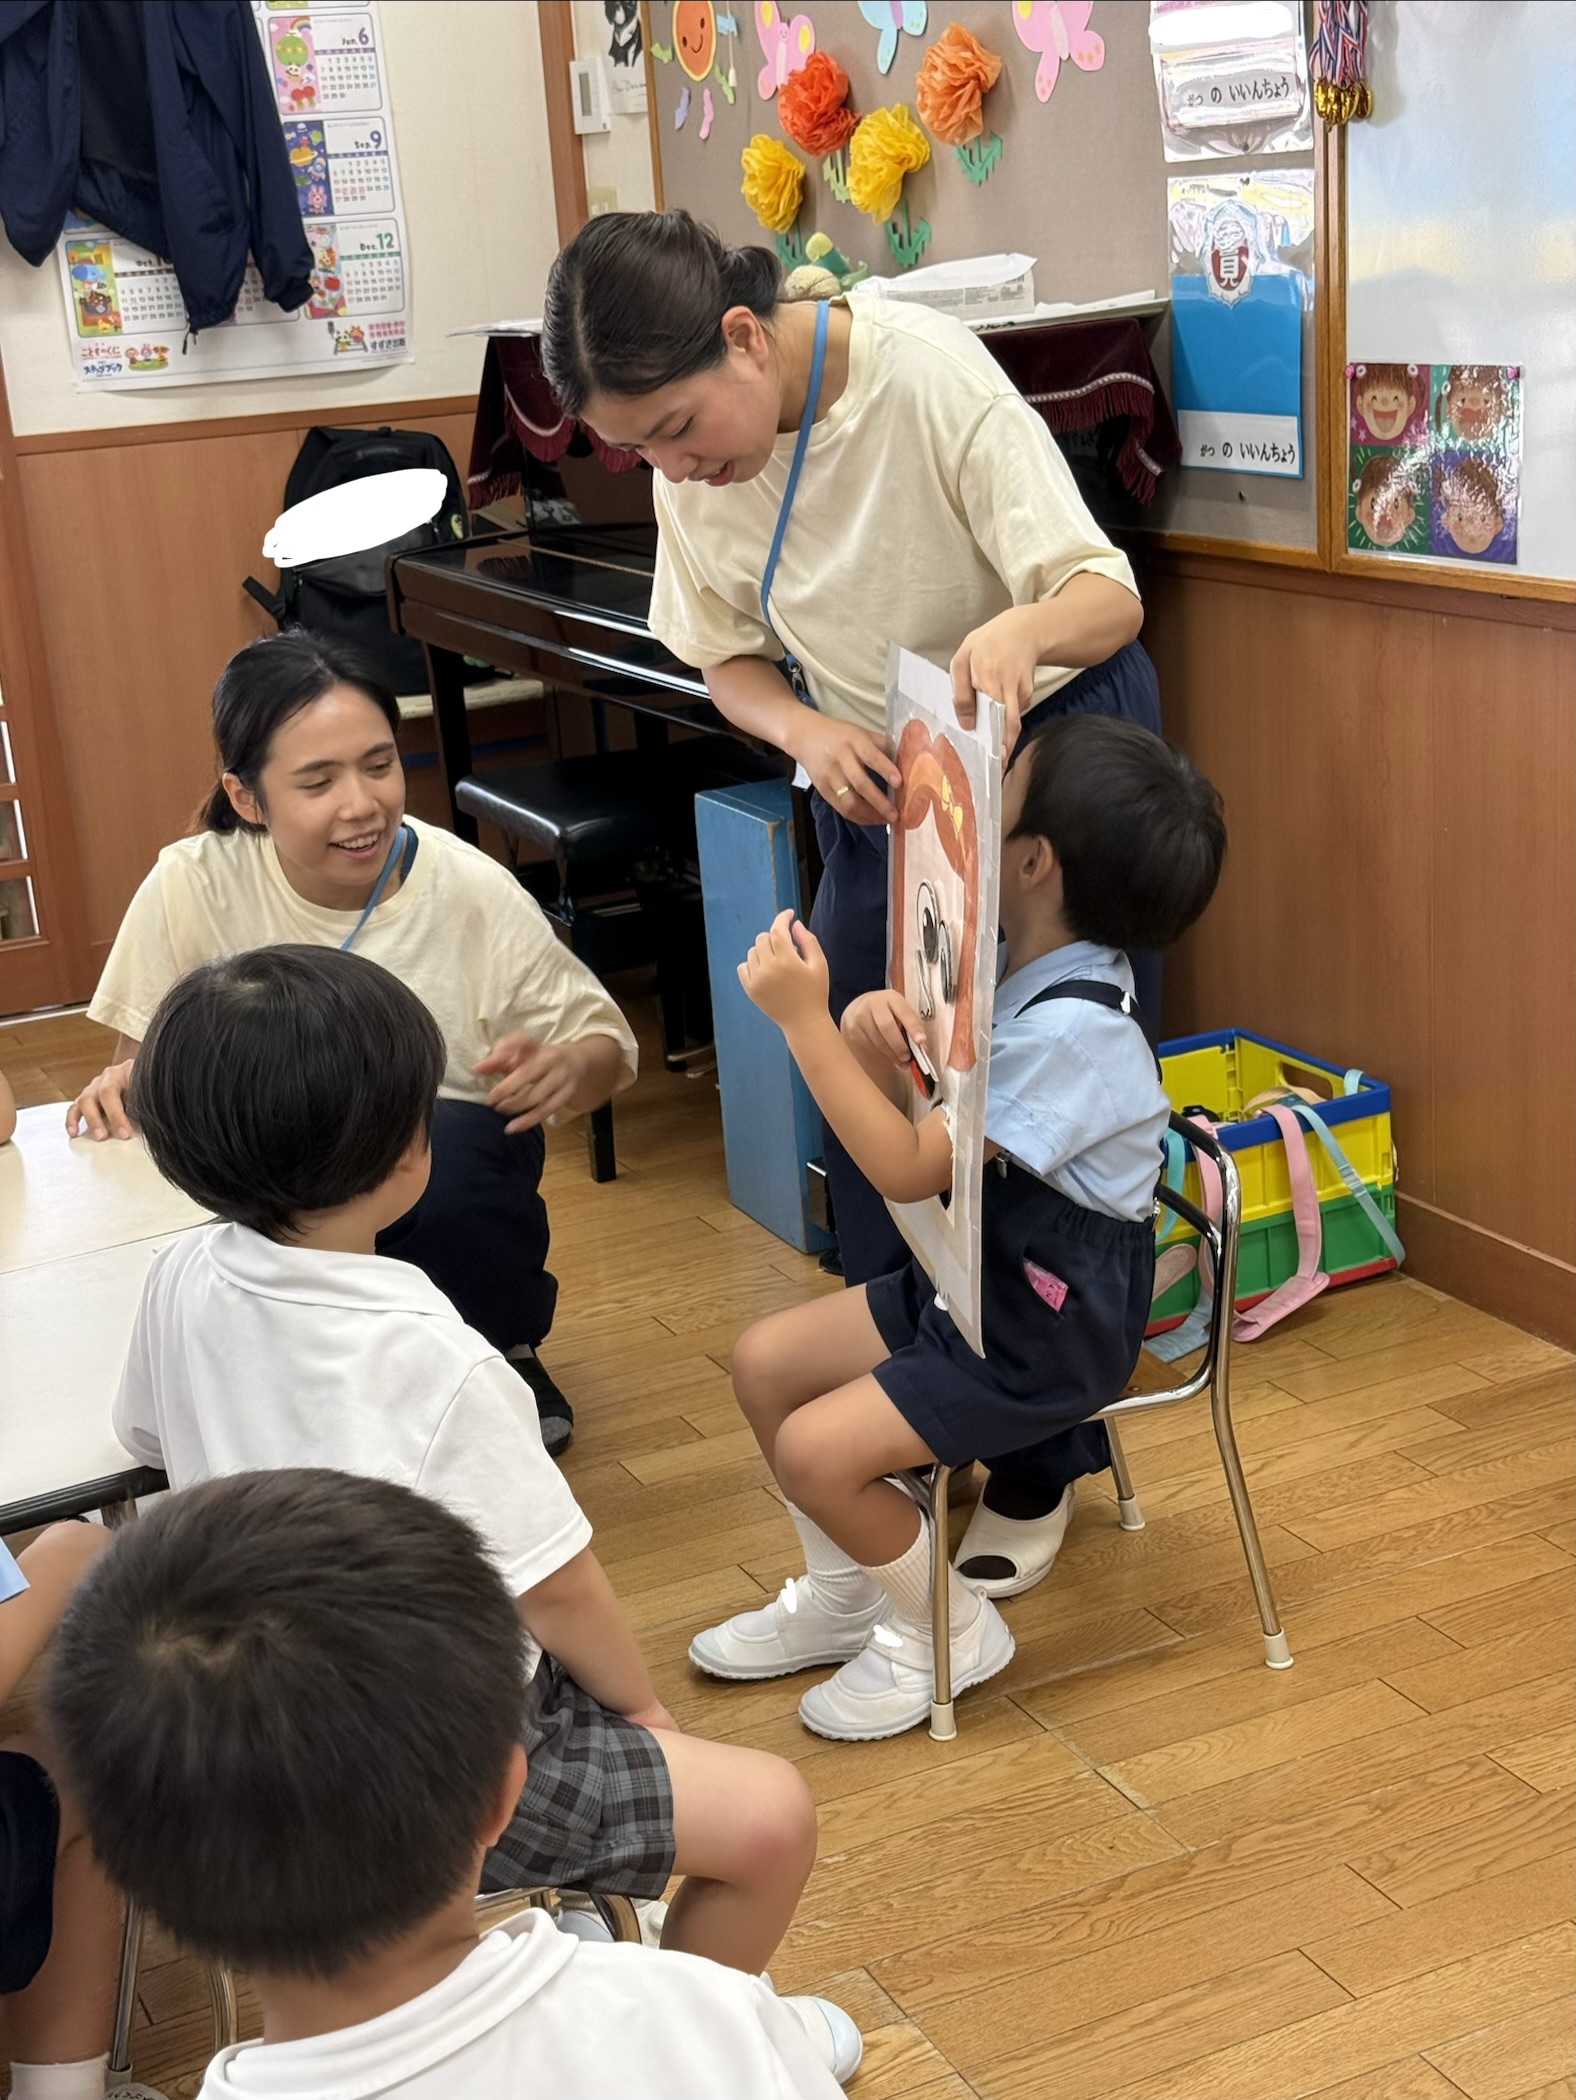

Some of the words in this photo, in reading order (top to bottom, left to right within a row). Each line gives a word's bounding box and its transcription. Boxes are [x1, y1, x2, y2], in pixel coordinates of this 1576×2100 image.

[359, 27, 370, 46] 6
[1210, 87, 1222, 104] の
[1229, 76, 1290, 102] いいんちょう
[370, 130, 382, 150] 9
[376, 233, 395, 251] 12
[1222, 442, 1233, 458] の
[1240, 442, 1296, 464] いいんちょう
